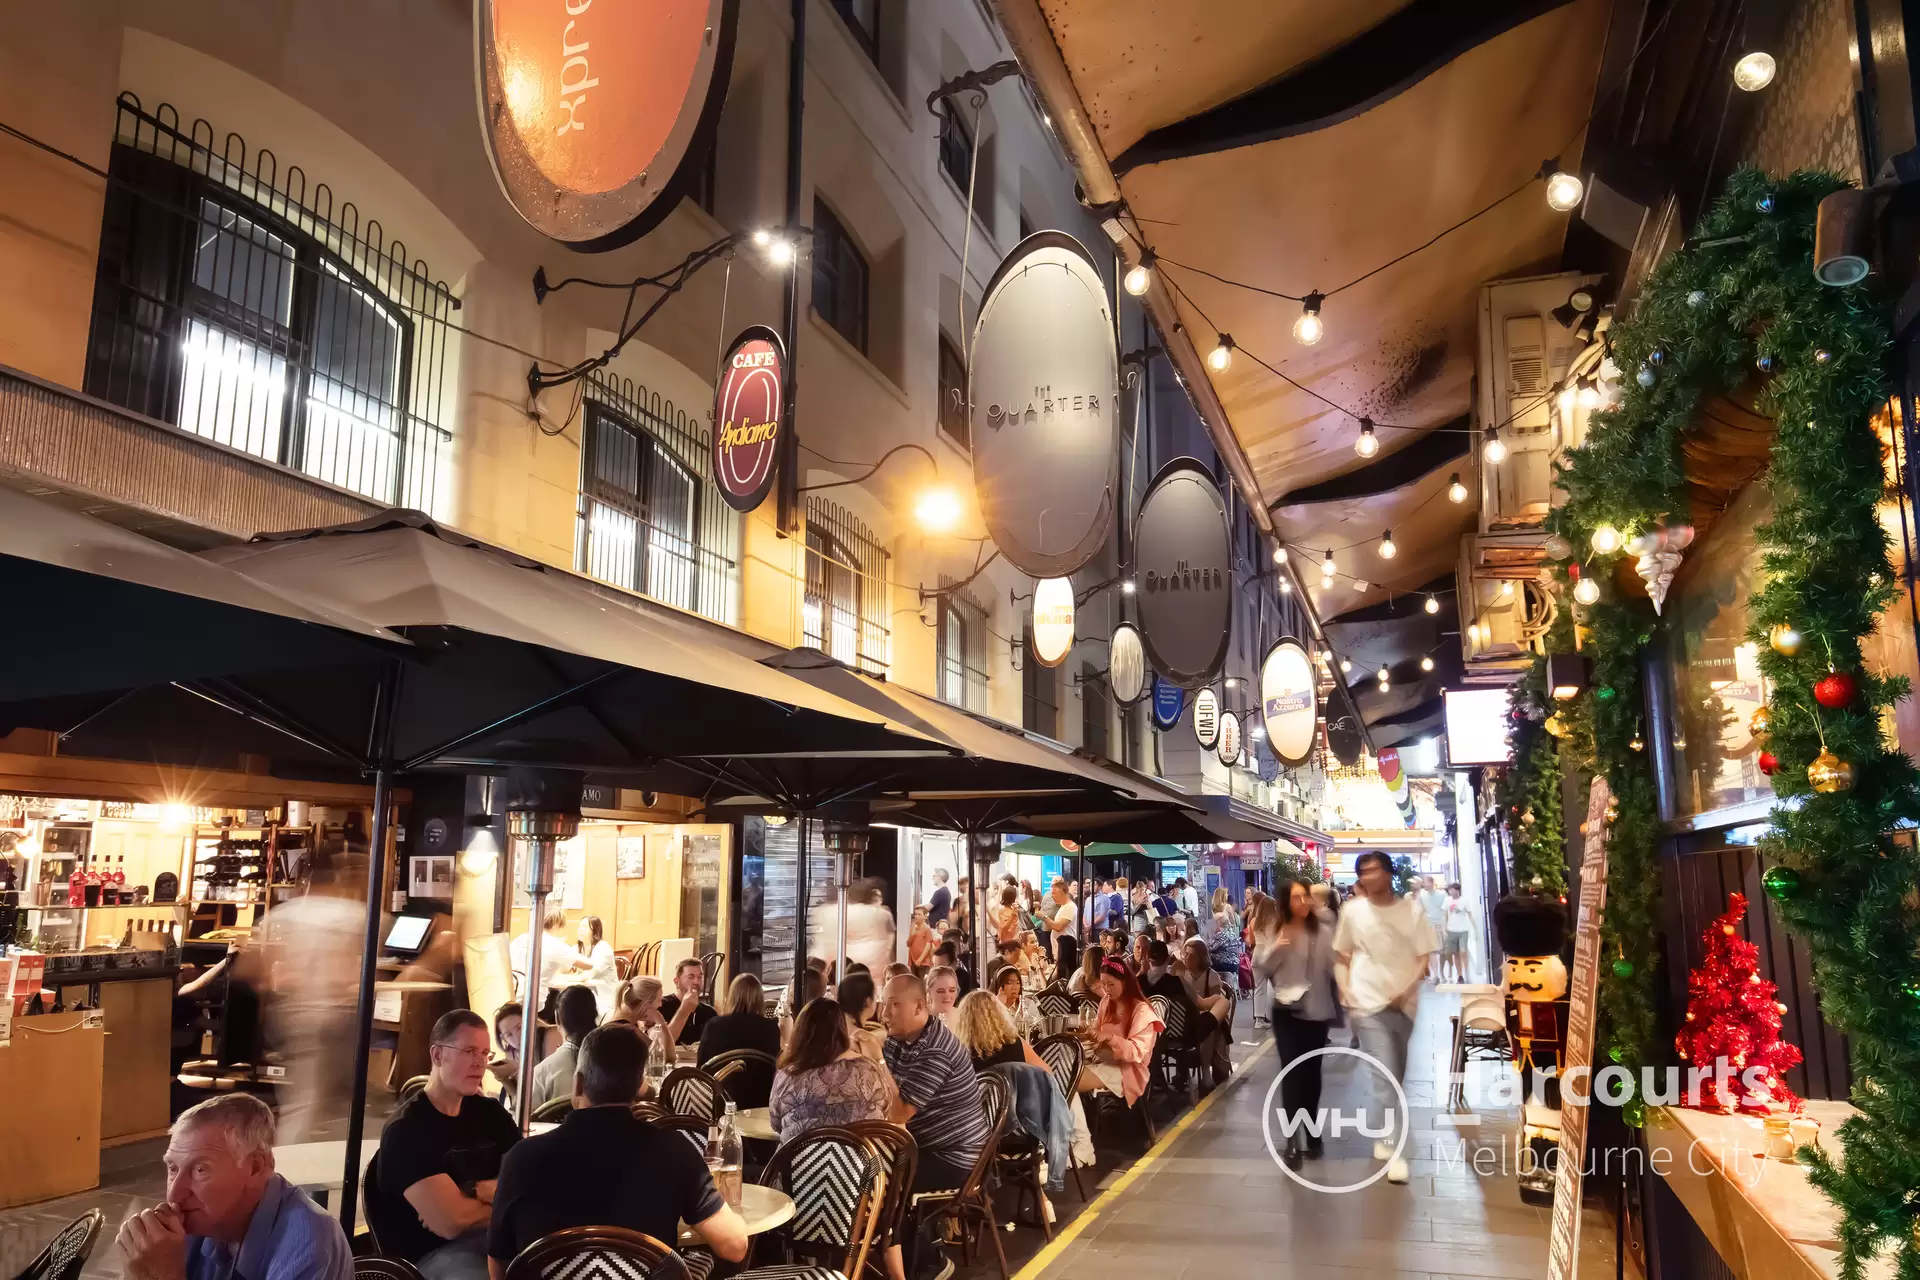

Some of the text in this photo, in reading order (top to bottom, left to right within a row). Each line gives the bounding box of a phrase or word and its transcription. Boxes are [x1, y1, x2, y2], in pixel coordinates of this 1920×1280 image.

[732, 347, 776, 369] CAFÉ
[987, 395, 1100, 423] QUARTER
[718, 417, 778, 454] Andiamo
[1146, 567, 1221, 583] QUARTER
[1272, 702, 1305, 712] Azzurro
[1275, 697, 1303, 706] Nastro
